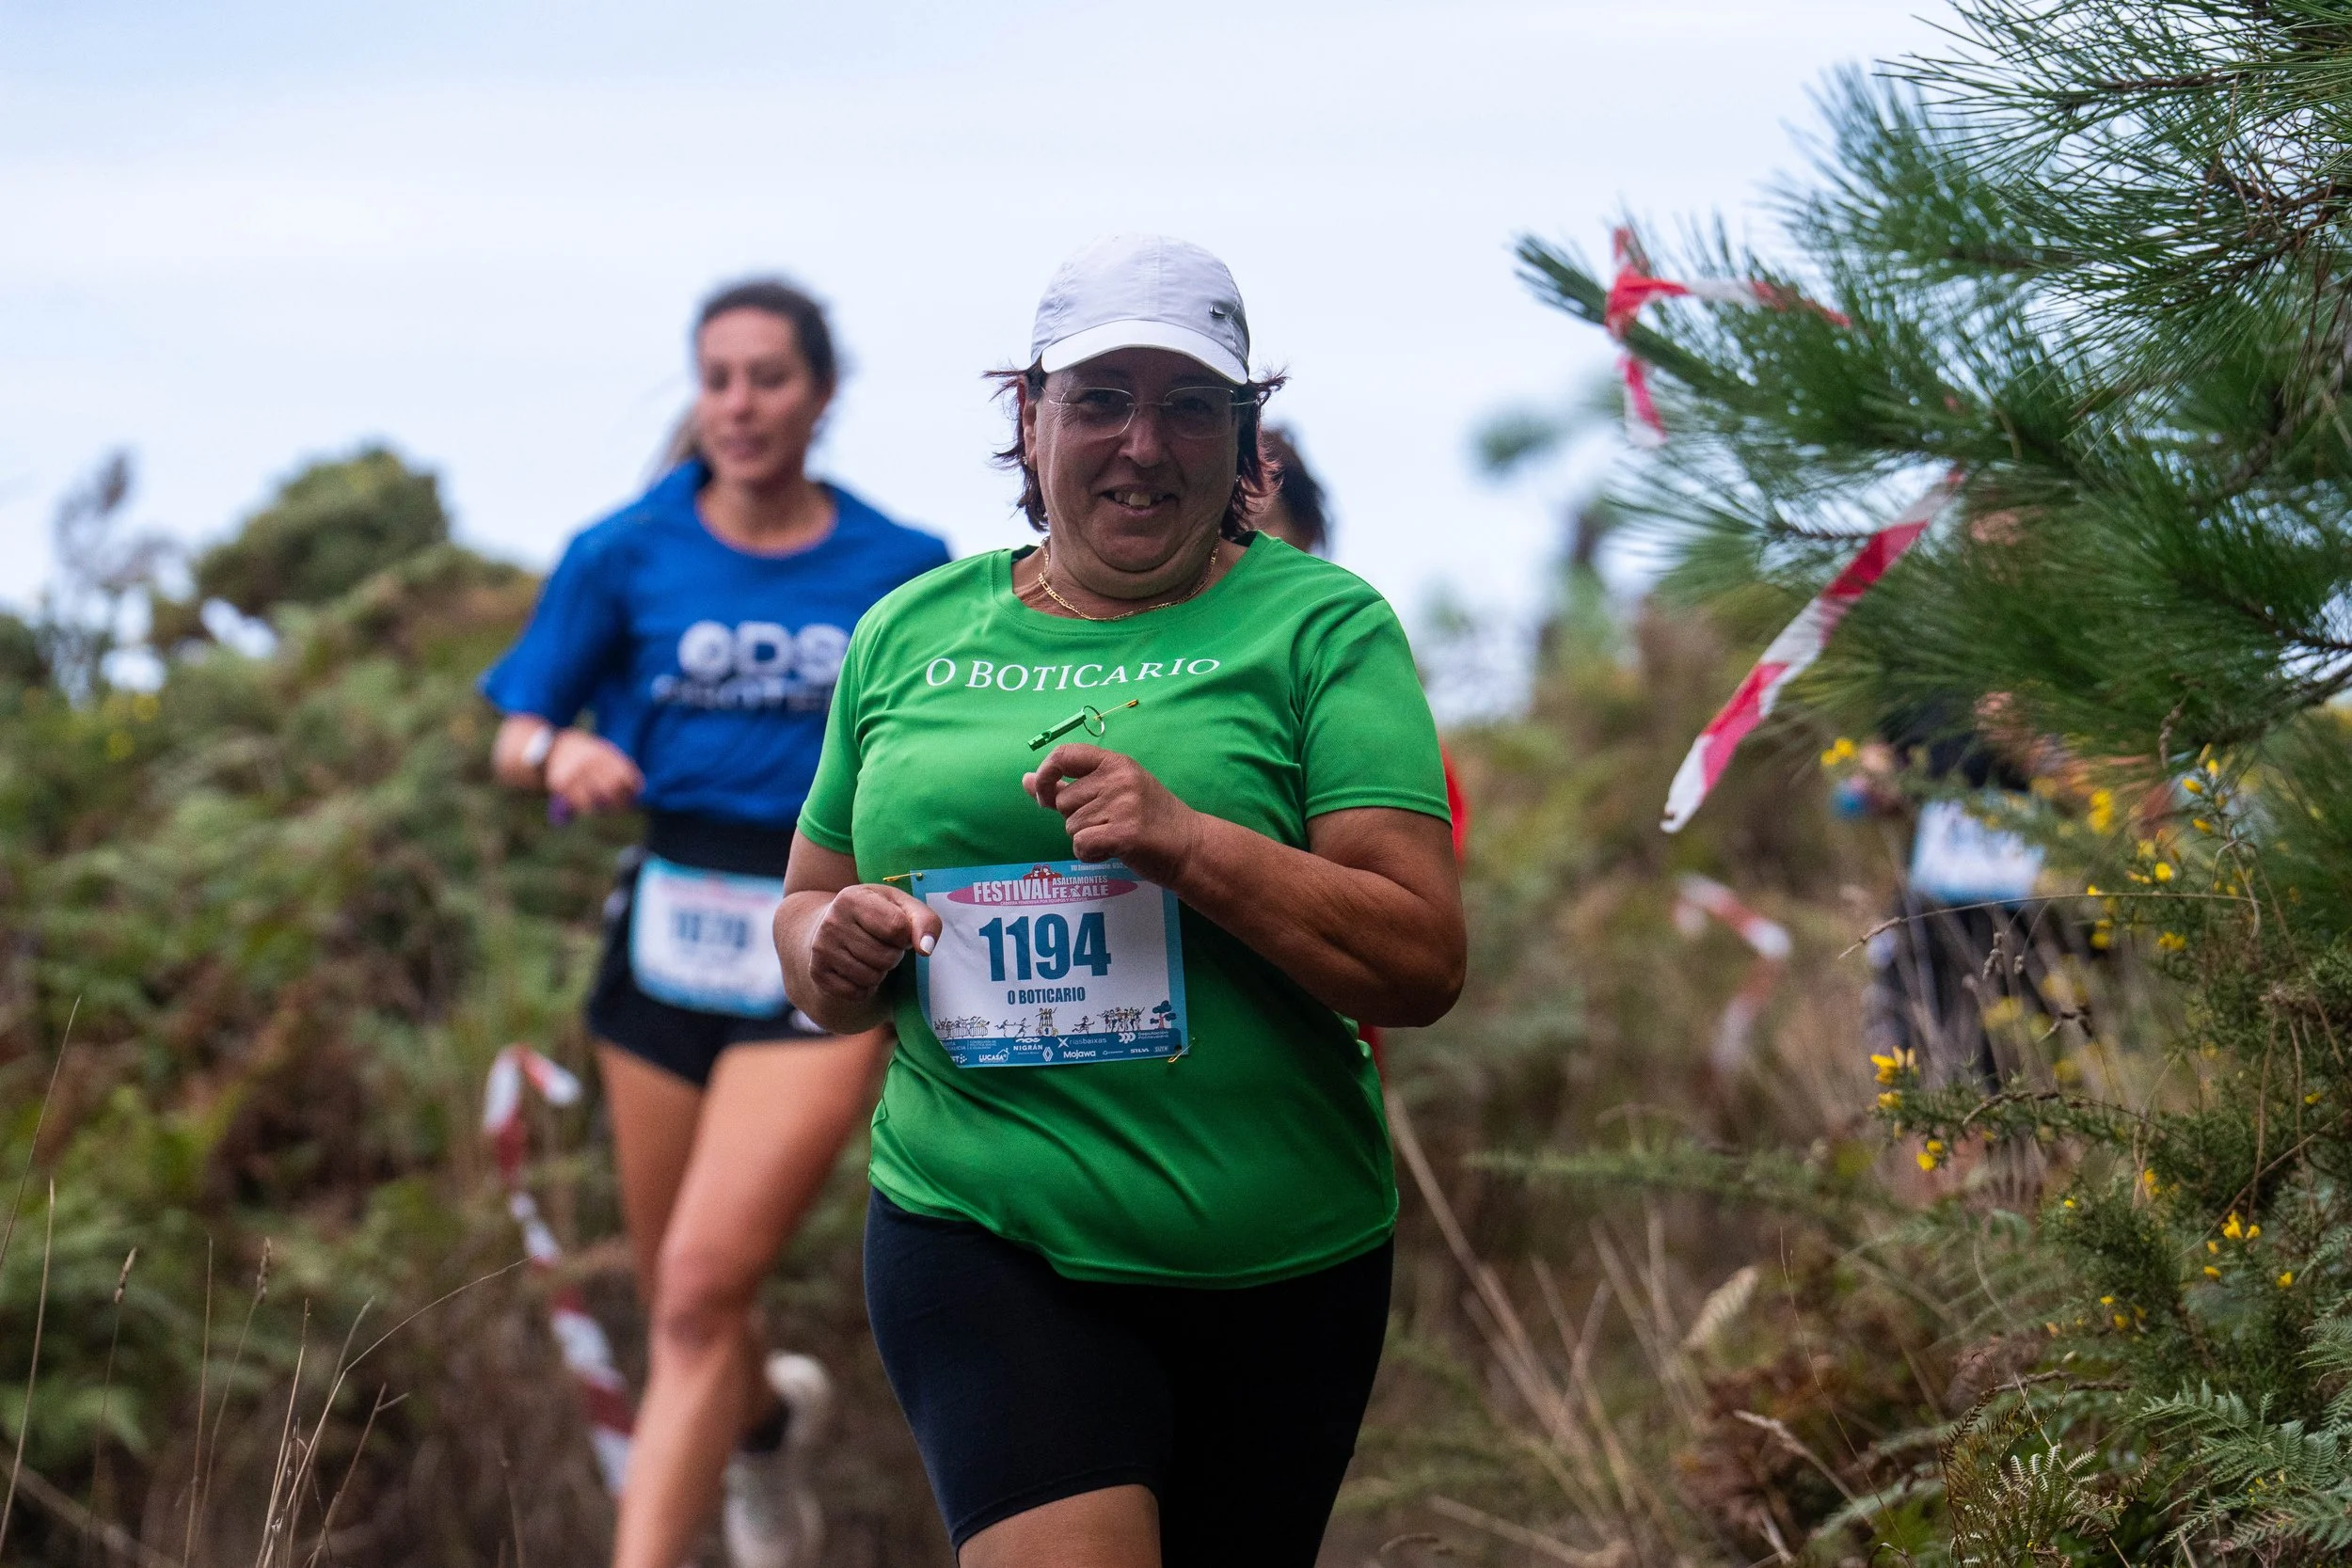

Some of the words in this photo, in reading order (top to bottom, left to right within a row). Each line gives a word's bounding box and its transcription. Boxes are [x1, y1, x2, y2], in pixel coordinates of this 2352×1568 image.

[926, 657, 956, 687] O
[965, 657, 1221, 691] BOTICARIO
[973, 878, 1053, 903] FESTIVAL
[1052, 875, 1108, 886] ASALTAMONTES
[979, 911, 1112, 982] 1194
[1007, 990, 1016, 1006] O
[1018, 986, 1086, 1005] BOTICARIO
[1063, 1049, 1096, 1060] Mojawa
